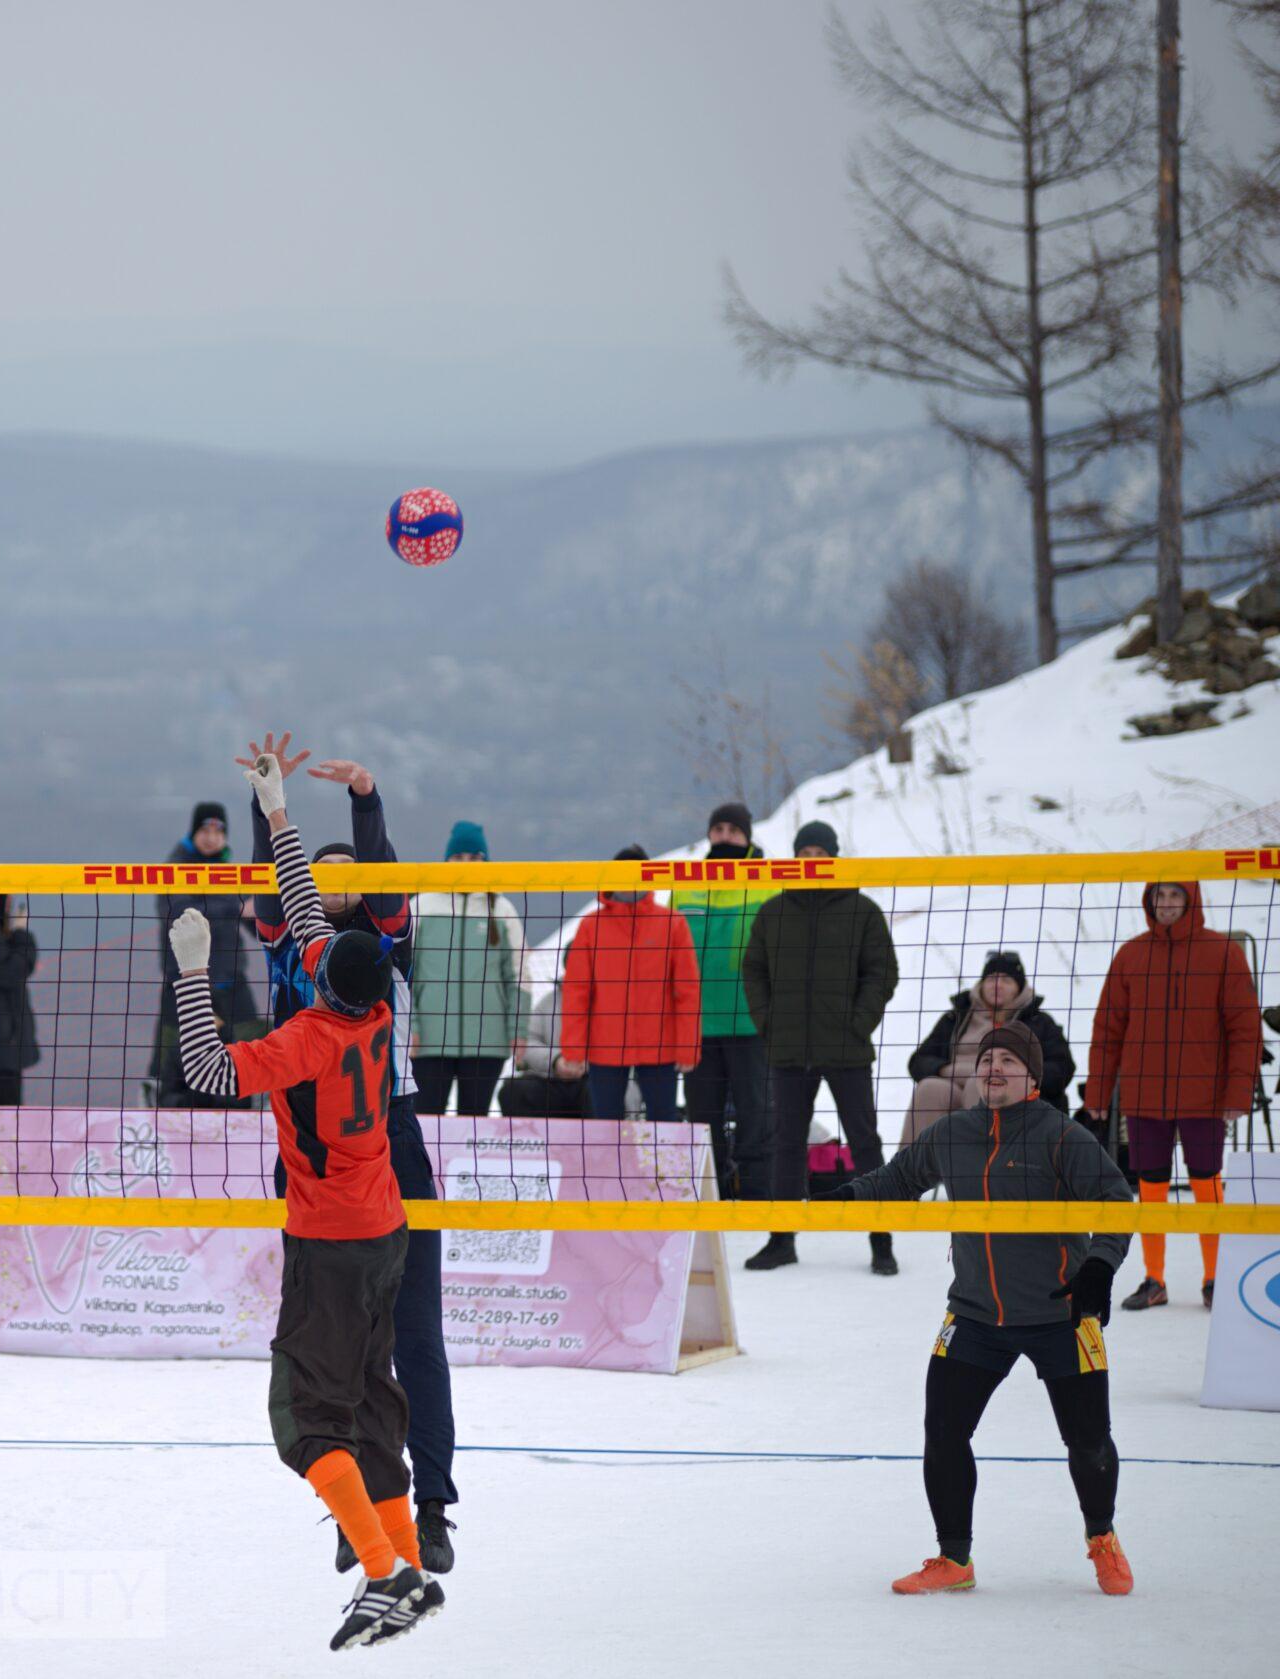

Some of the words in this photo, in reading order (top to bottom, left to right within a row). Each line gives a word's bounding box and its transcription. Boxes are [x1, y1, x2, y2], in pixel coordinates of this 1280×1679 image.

[84, 865, 270, 885] FUNTEC
[641, 860, 835, 881] FUNTEC
[465, 1137, 547, 1151] INSTAGRAM
[93, 1229, 191, 1273] Viktoria
[102, 1274, 180, 1292] PRONAILS
[558, 1336, 583, 1349] 10%
